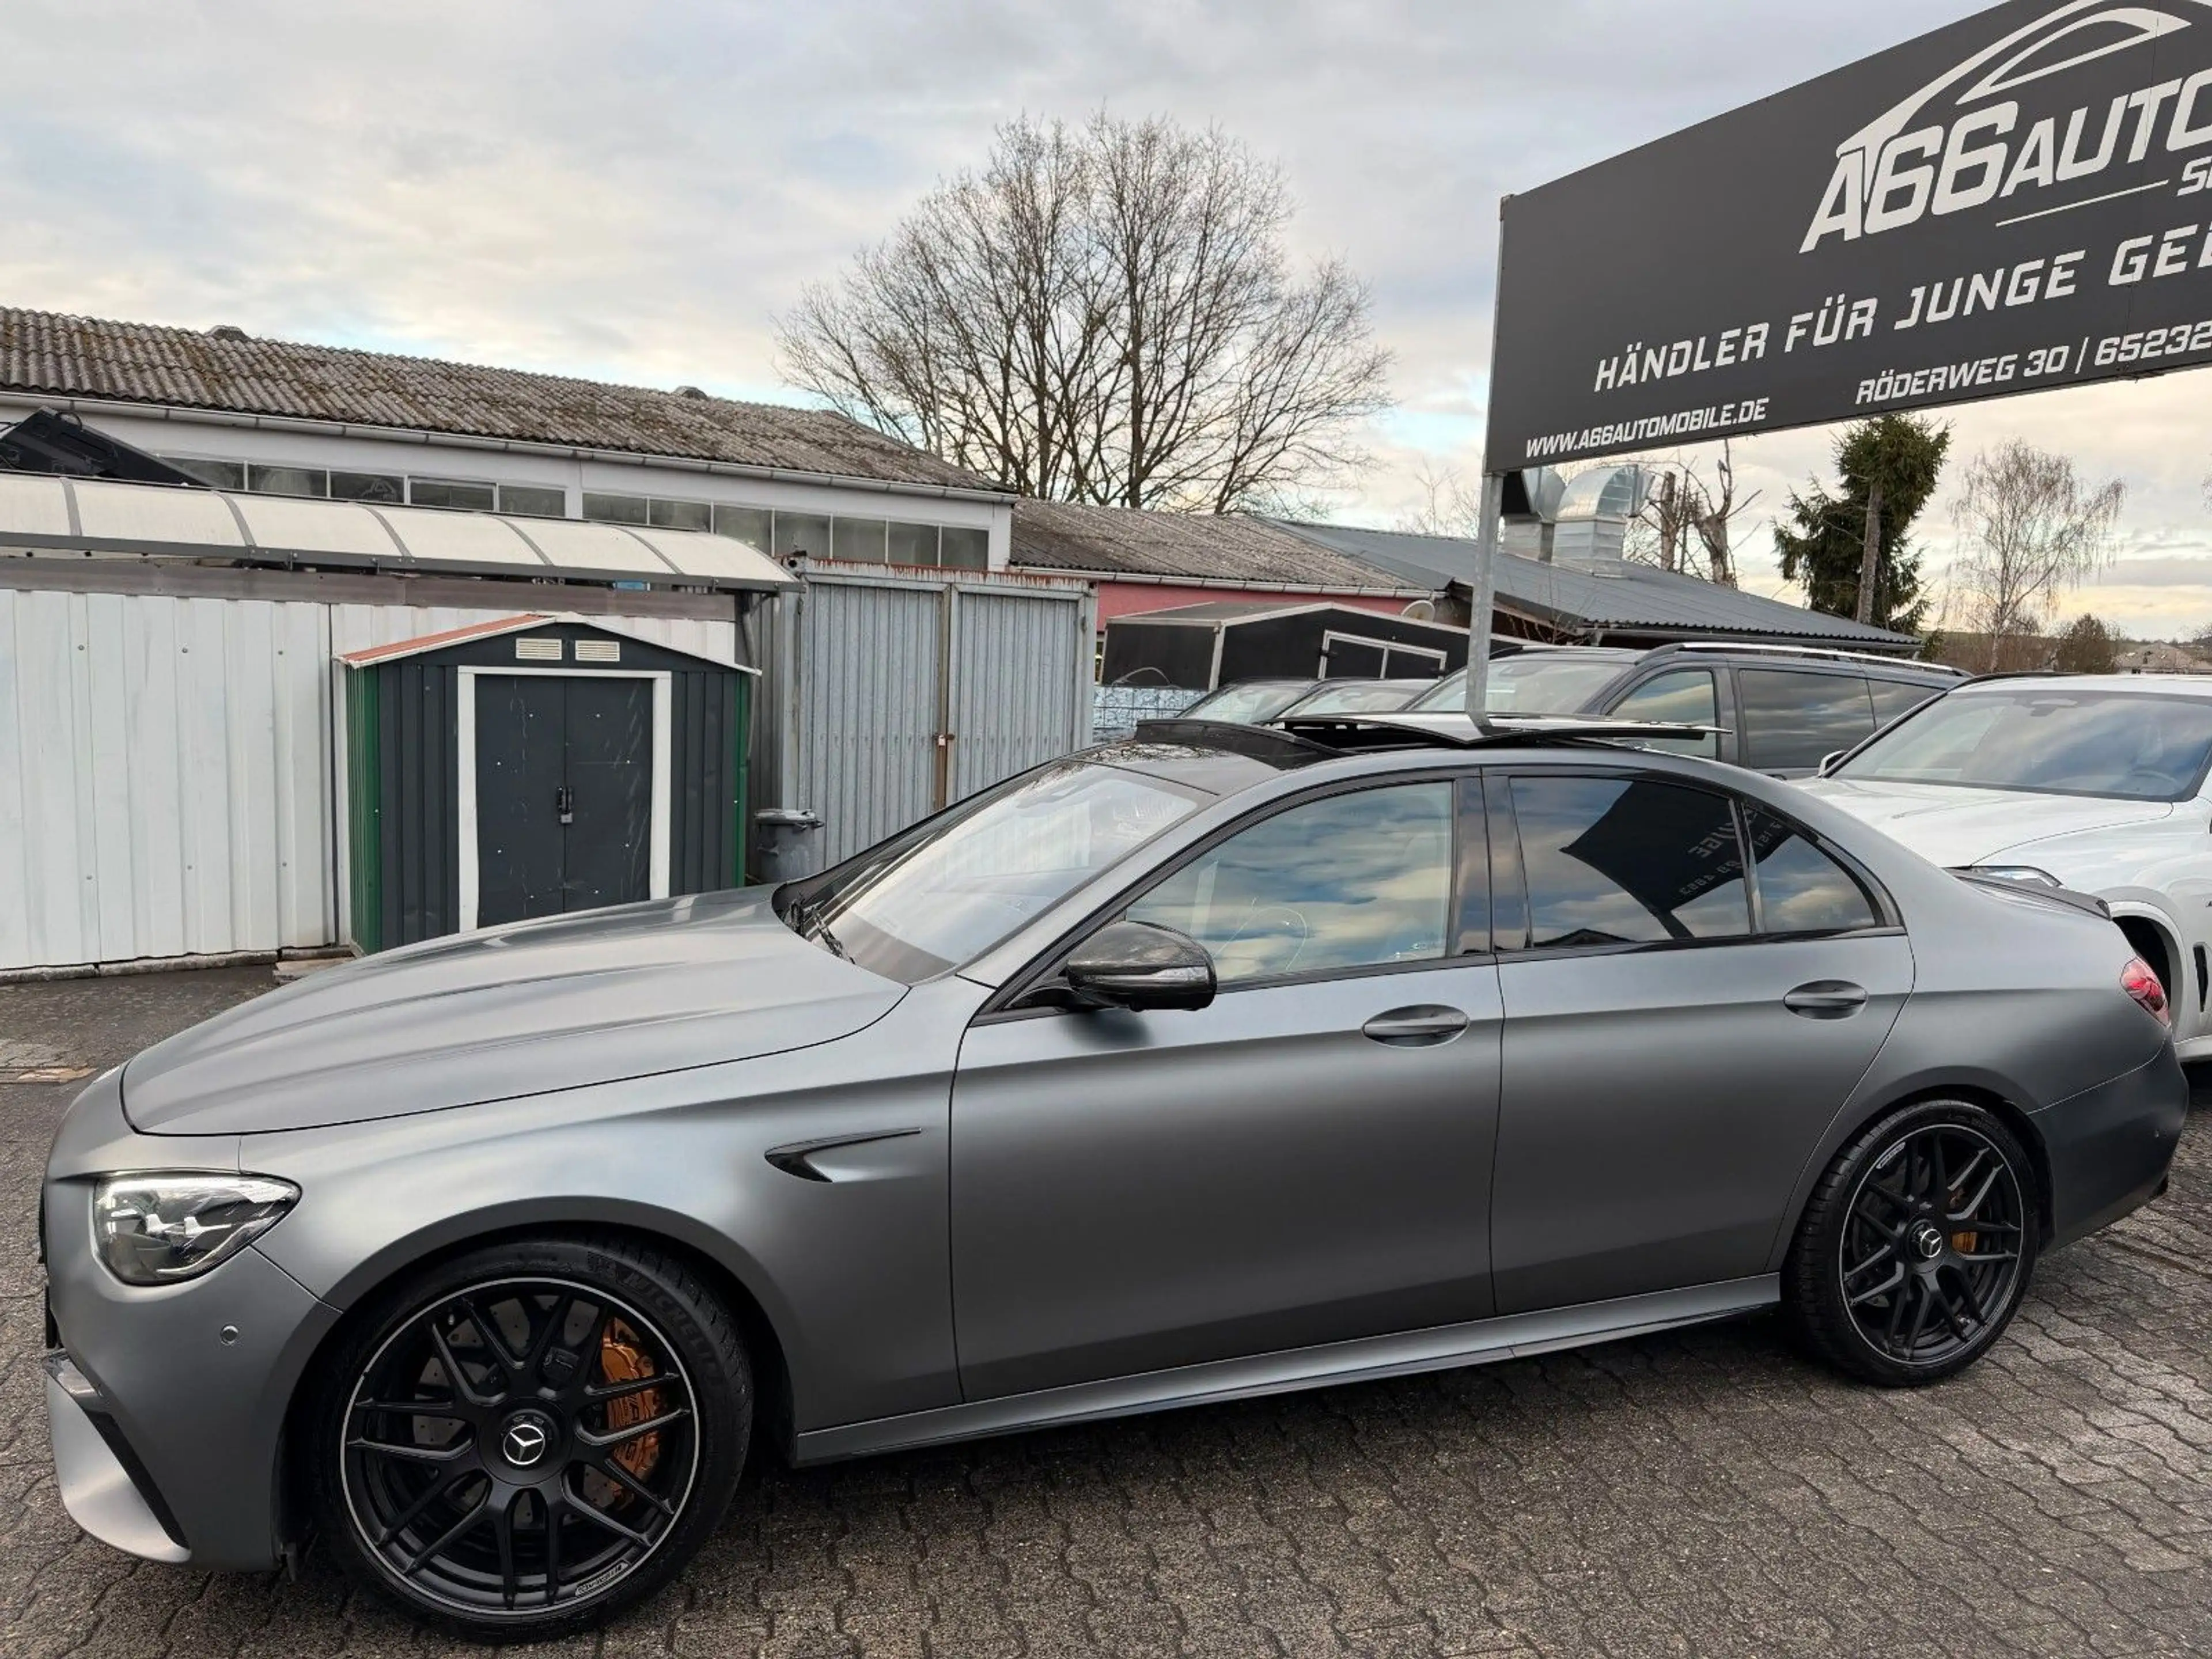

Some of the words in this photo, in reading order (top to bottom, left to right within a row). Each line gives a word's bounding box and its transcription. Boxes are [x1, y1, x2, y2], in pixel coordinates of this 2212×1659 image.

[2177, 156, 2212, 196] S
[1594, 322, 1770, 392] HÄNDLER
[1785, 293, 1877, 353] FÜR
[1894, 249, 2086, 330] JUNGE
[1855, 354, 2018, 404] RÖDERWEG
[2023, 346, 2070, 377] 30
[2094, 320, 2212, 366] 65232
[1527, 397, 1770, 458] WWW.A66AUTOMOBILE.DE
